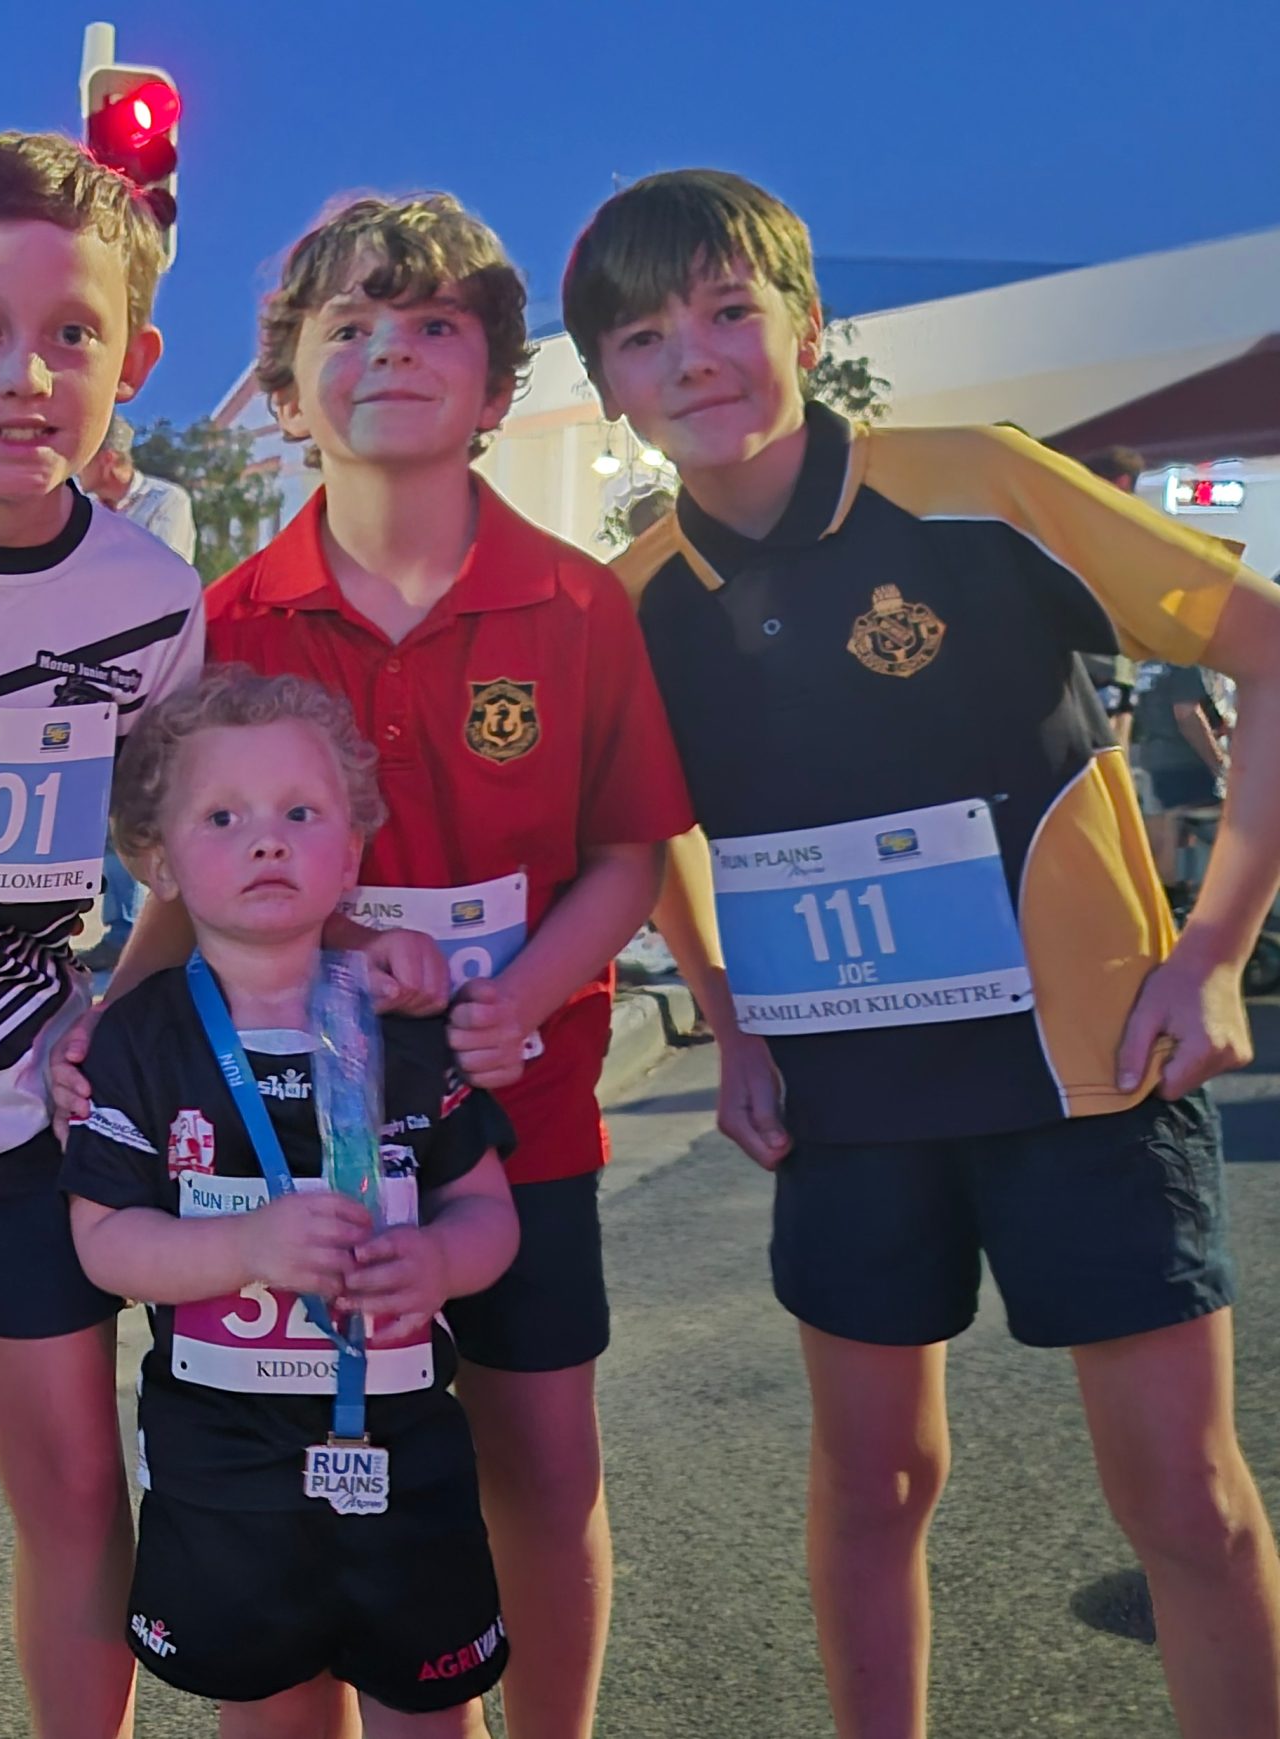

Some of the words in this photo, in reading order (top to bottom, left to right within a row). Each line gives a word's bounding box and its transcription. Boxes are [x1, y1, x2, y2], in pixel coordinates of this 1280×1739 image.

[39, 655, 76, 674] Moree
[755, 845, 823, 868] PLAINS
[794, 884, 896, 961] 111
[838, 961, 878, 986] JOE
[868, 983, 1003, 1013] KILOMETRE
[218, 1052, 245, 1088] RUN
[193, 1189, 222, 1209] RUN
[232, 1195, 268, 1212] PLA
[257, 1360, 340, 1378] KIDDOS
[313, 1452, 372, 1475] RUN
[311, 1475, 384, 1495] PLAINS
